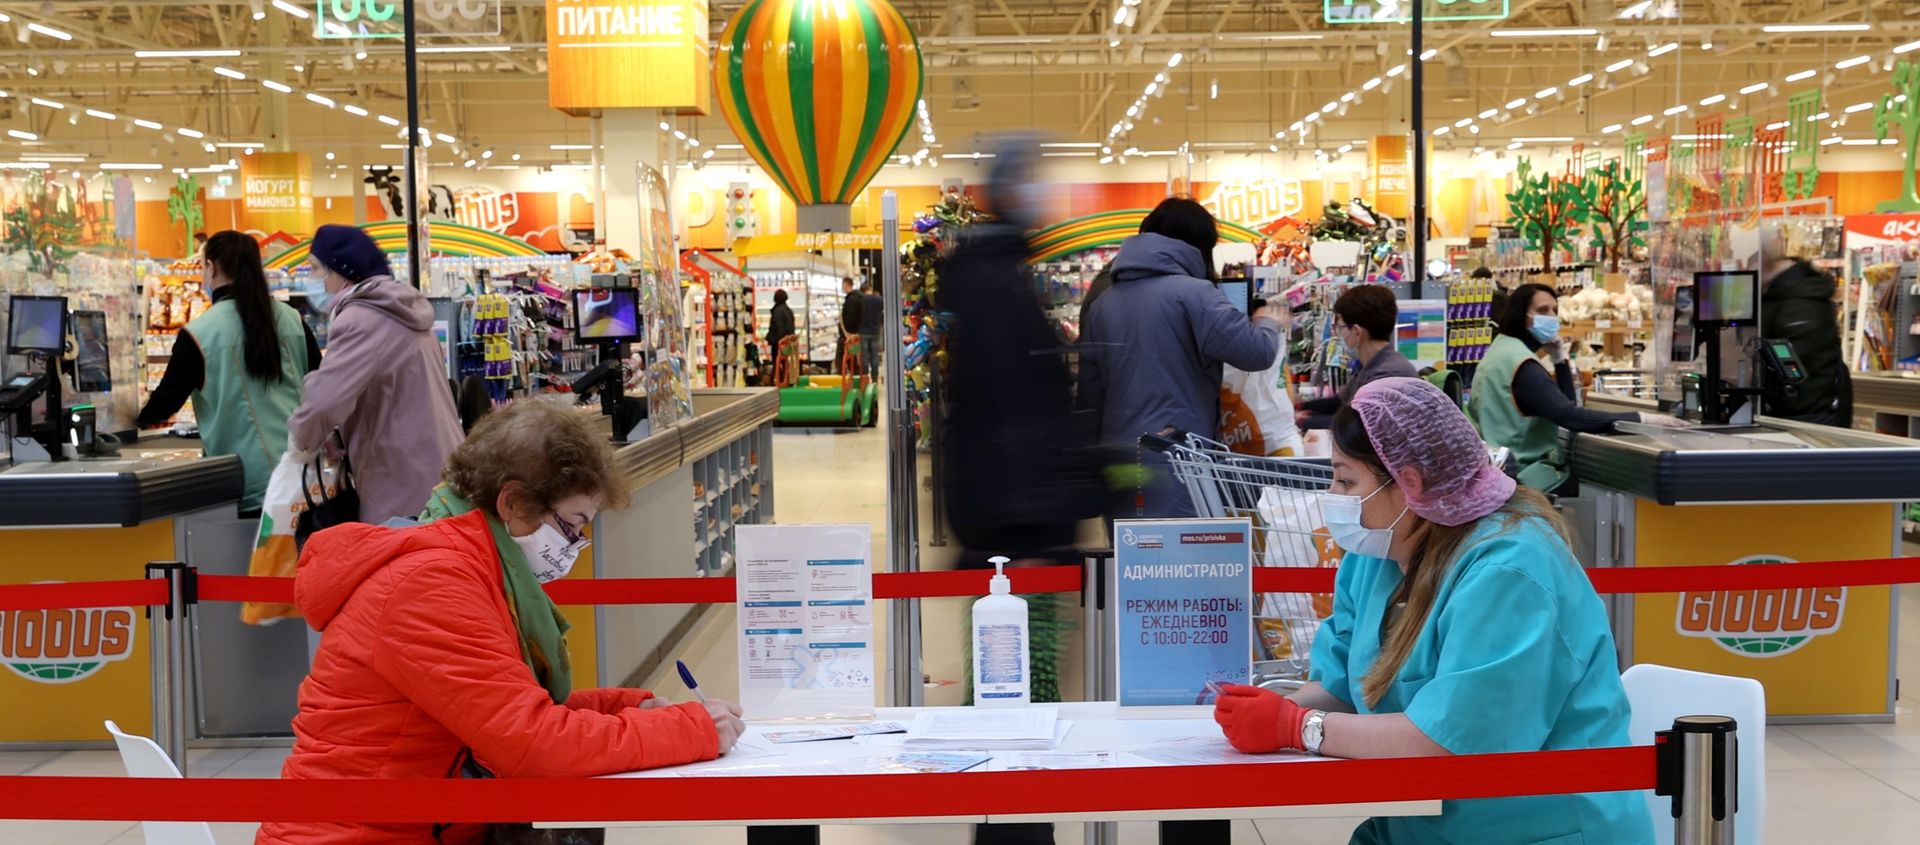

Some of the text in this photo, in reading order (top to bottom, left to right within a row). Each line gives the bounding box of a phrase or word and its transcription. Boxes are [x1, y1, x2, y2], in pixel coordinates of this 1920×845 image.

[558, 5, 682, 36] ПИТАНИЕ
[246, 175, 295, 194] ЙОГУРТ
[246, 195, 296, 208] МАЙОНЕЗ
[1182, 534, 1227, 542] mos.ru/privivka
[1123, 563, 1244, 580] АДМИНИСТРАТОР
[1126, 598, 1243, 613] РЕЖИМ РАБОТЫ:
[1142, 614, 1227, 630] ЕЖЕДНЕВНО
[1141, 630, 1228, 645] С 10:00-22:00
